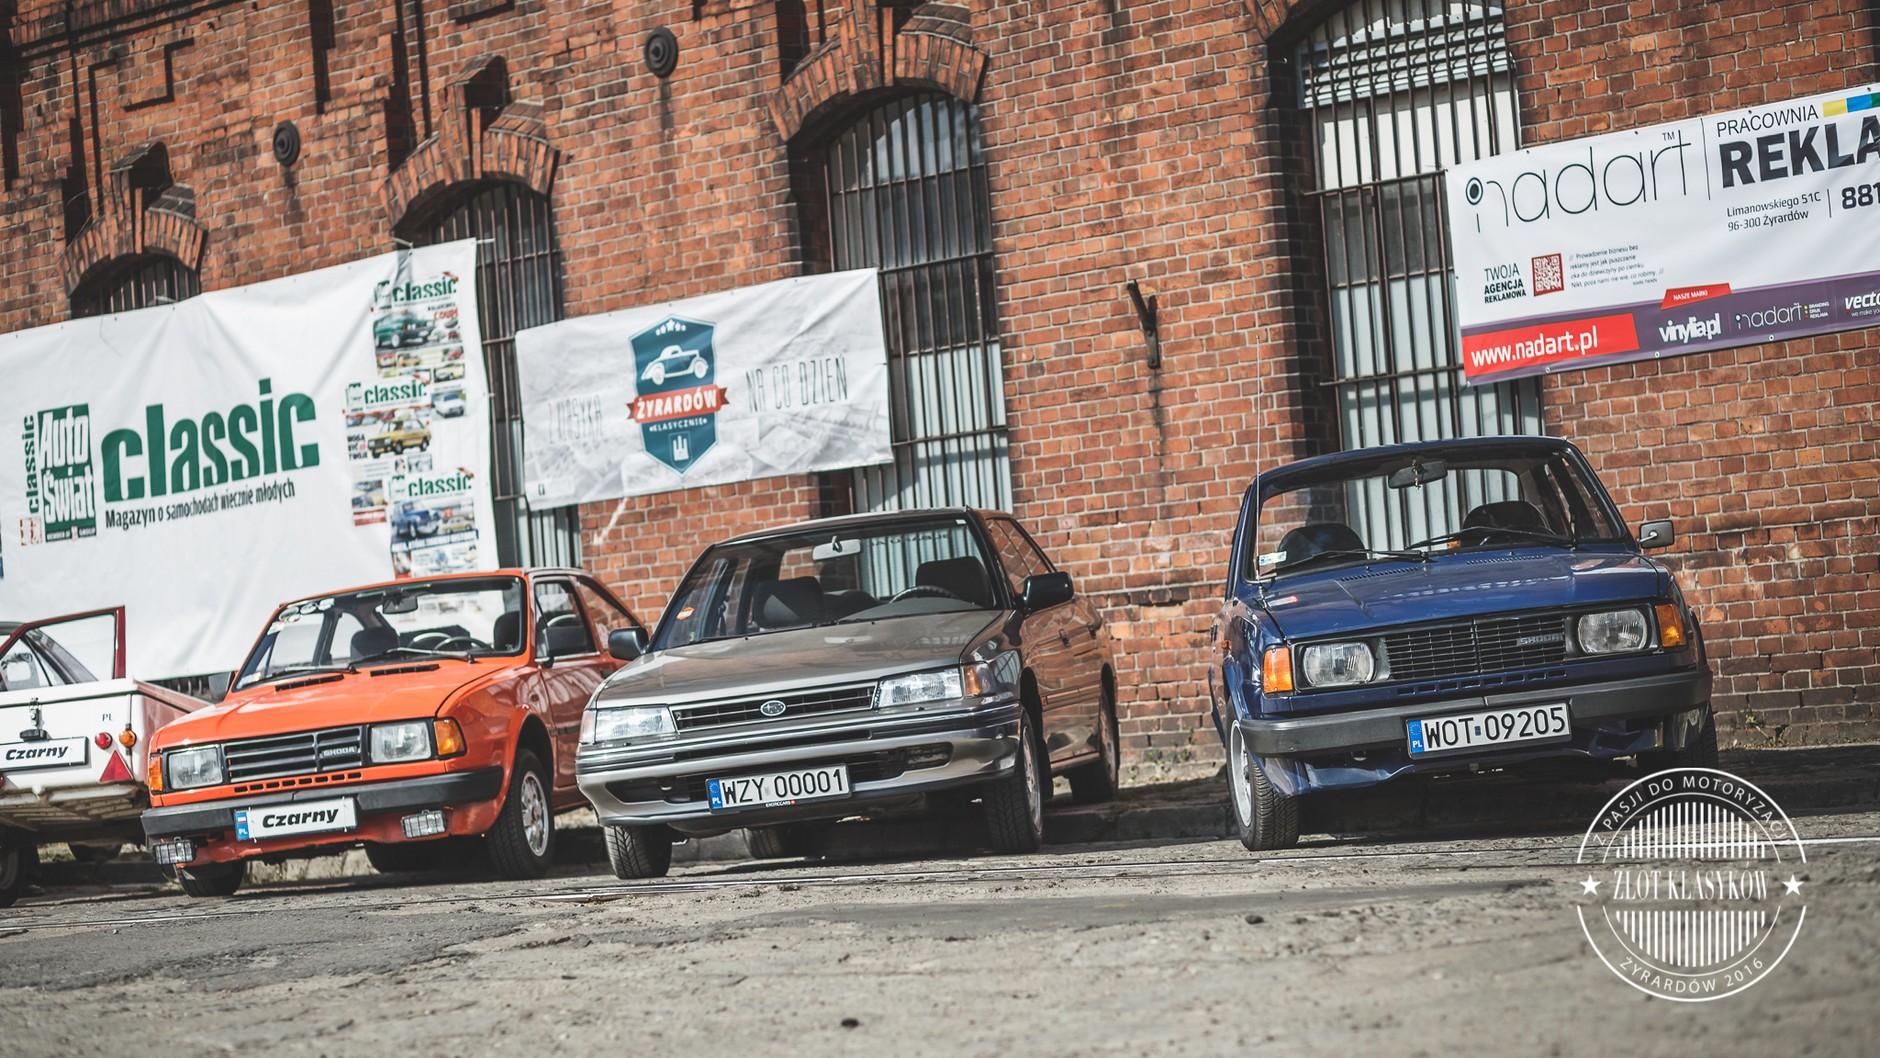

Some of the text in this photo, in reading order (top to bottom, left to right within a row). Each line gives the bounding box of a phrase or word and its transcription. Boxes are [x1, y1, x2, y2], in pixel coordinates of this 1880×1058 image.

[1717, 104, 1819, 138] PRACOWNIA
[1727, 191, 1822, 218] Limanowskiego 51C
[1728, 209, 1809, 232] 96-300 Żyrardów
[1483, 262, 1520, 282] TWOJA
[393, 277, 457, 302] classic
[1484, 278, 1524, 295] AGENCJA
[1484, 288, 1527, 304] REKLAMOWA
[1672, 289, 1709, 301] NASZE MARKI
[1471, 325, 1599, 367] www.nadart.pl
[364, 379, 427, 404] classic
[745, 369, 766, 414] NA
[773, 364, 792, 410] CO
[636, 387, 717, 420] ŻYRARDÓW
[38, 406, 89, 469] Auto
[652, 417, 703, 432] KLASYCZNIE
[101, 378, 321, 503] classic
[22, 415, 39, 514] classic
[43, 464, 95, 524] Świat
[408, 472, 472, 497] classic
[105, 478, 295, 531] Magazyn o samochodach wiecznie młodych
[102, 713, 113, 721] PL
[1412, 706, 1565, 749] PL WOT 09205
[5, 746, 69, 761] Czarny
[712, 769, 843, 805] PL WZY 00001
[262, 808, 339, 829] Czarny
